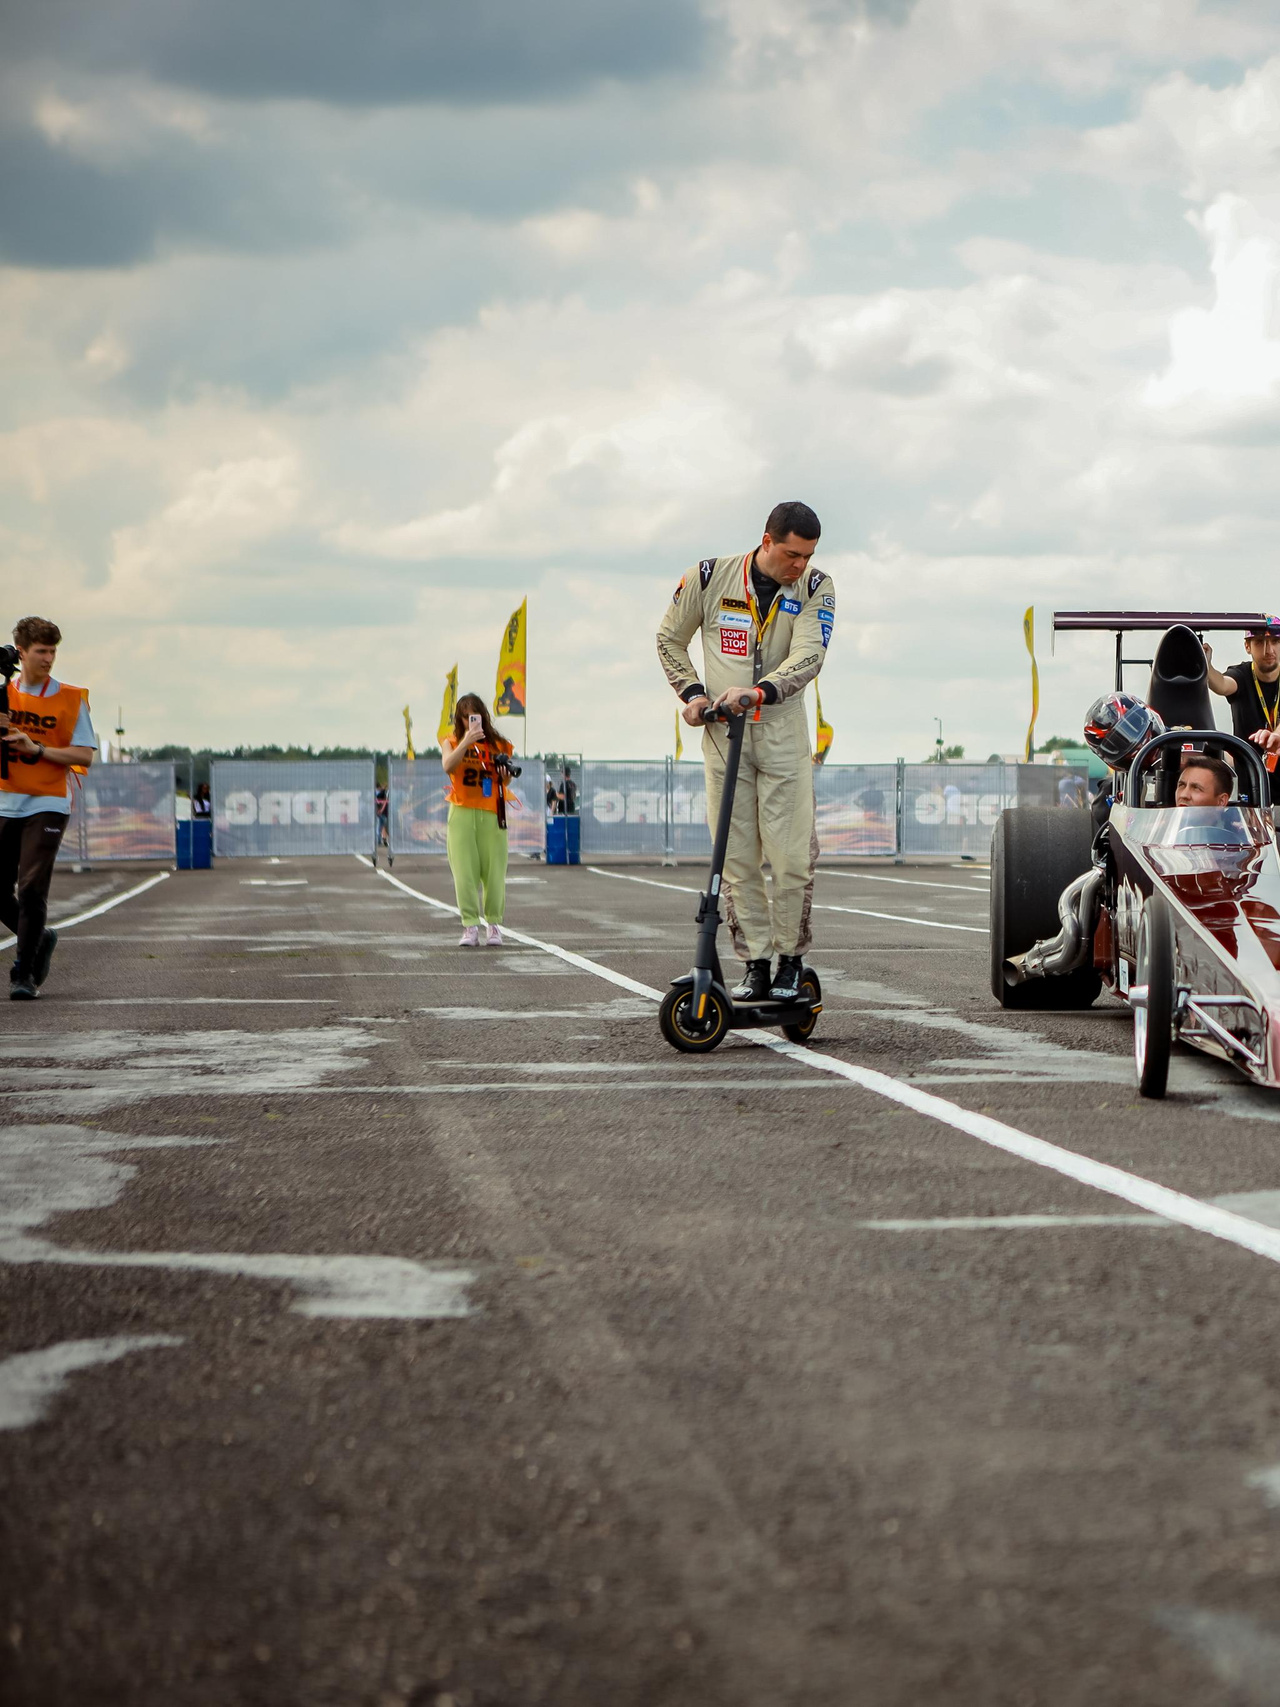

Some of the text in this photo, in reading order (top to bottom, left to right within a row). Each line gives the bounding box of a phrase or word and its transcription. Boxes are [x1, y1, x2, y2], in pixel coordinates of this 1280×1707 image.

[784, 601, 799, 613] ВТБ
[722, 629, 746, 640] DON'T
[722, 638, 746, 649] STOP
